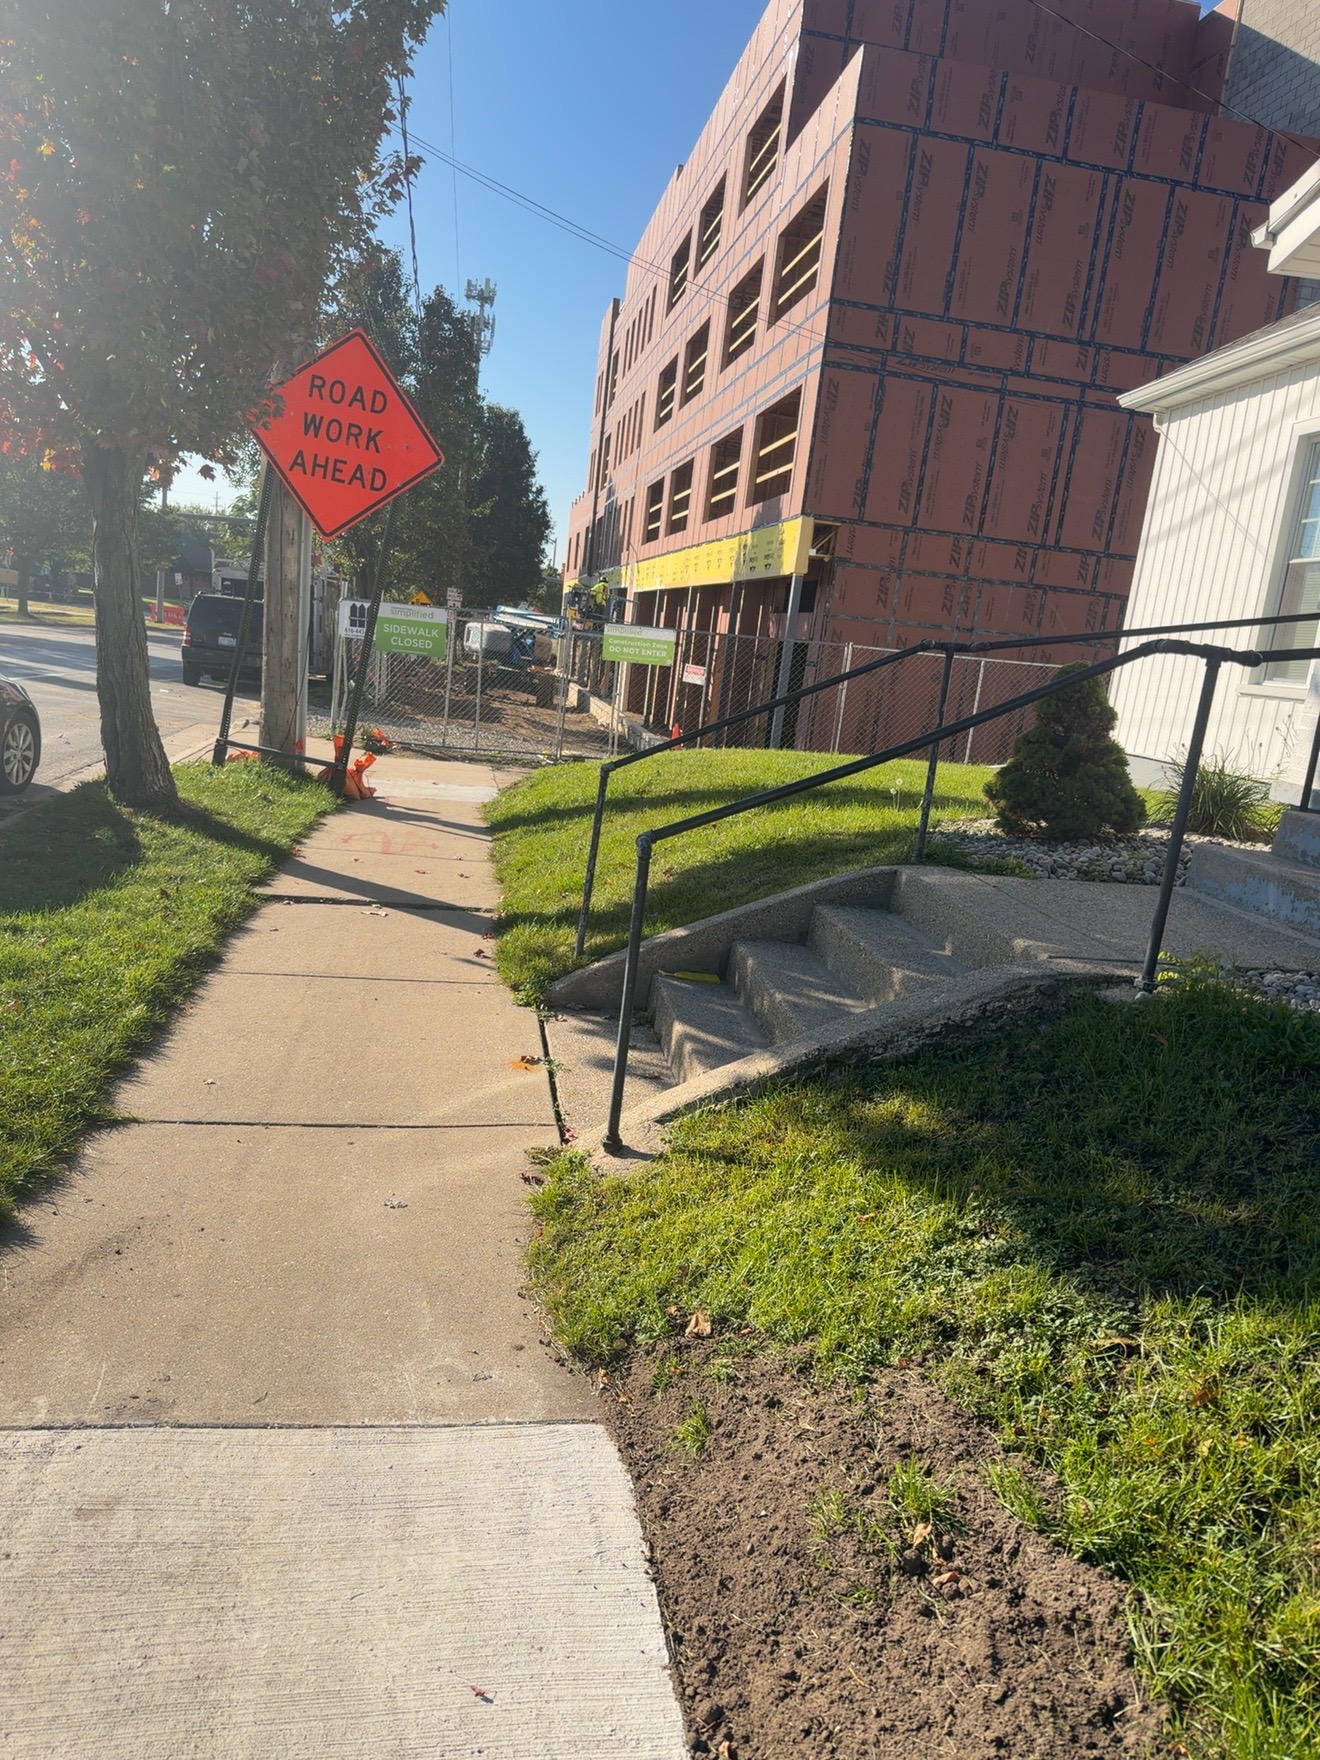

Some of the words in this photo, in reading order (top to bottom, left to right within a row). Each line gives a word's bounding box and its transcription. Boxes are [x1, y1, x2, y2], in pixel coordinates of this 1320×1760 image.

[308, 374, 388, 415] ROAD
[303, 412, 384, 454] WORK
[288, 450, 388, 492] AHEAD
[391, 608, 434, 619] simplified
[383, 623, 439, 638] SIDEWALK
[390, 636, 433, 649] CLOSED
[608, 638, 651, 647] Construction
[609, 645, 621, 653] DO
[642, 649, 667, 657] ENTER
